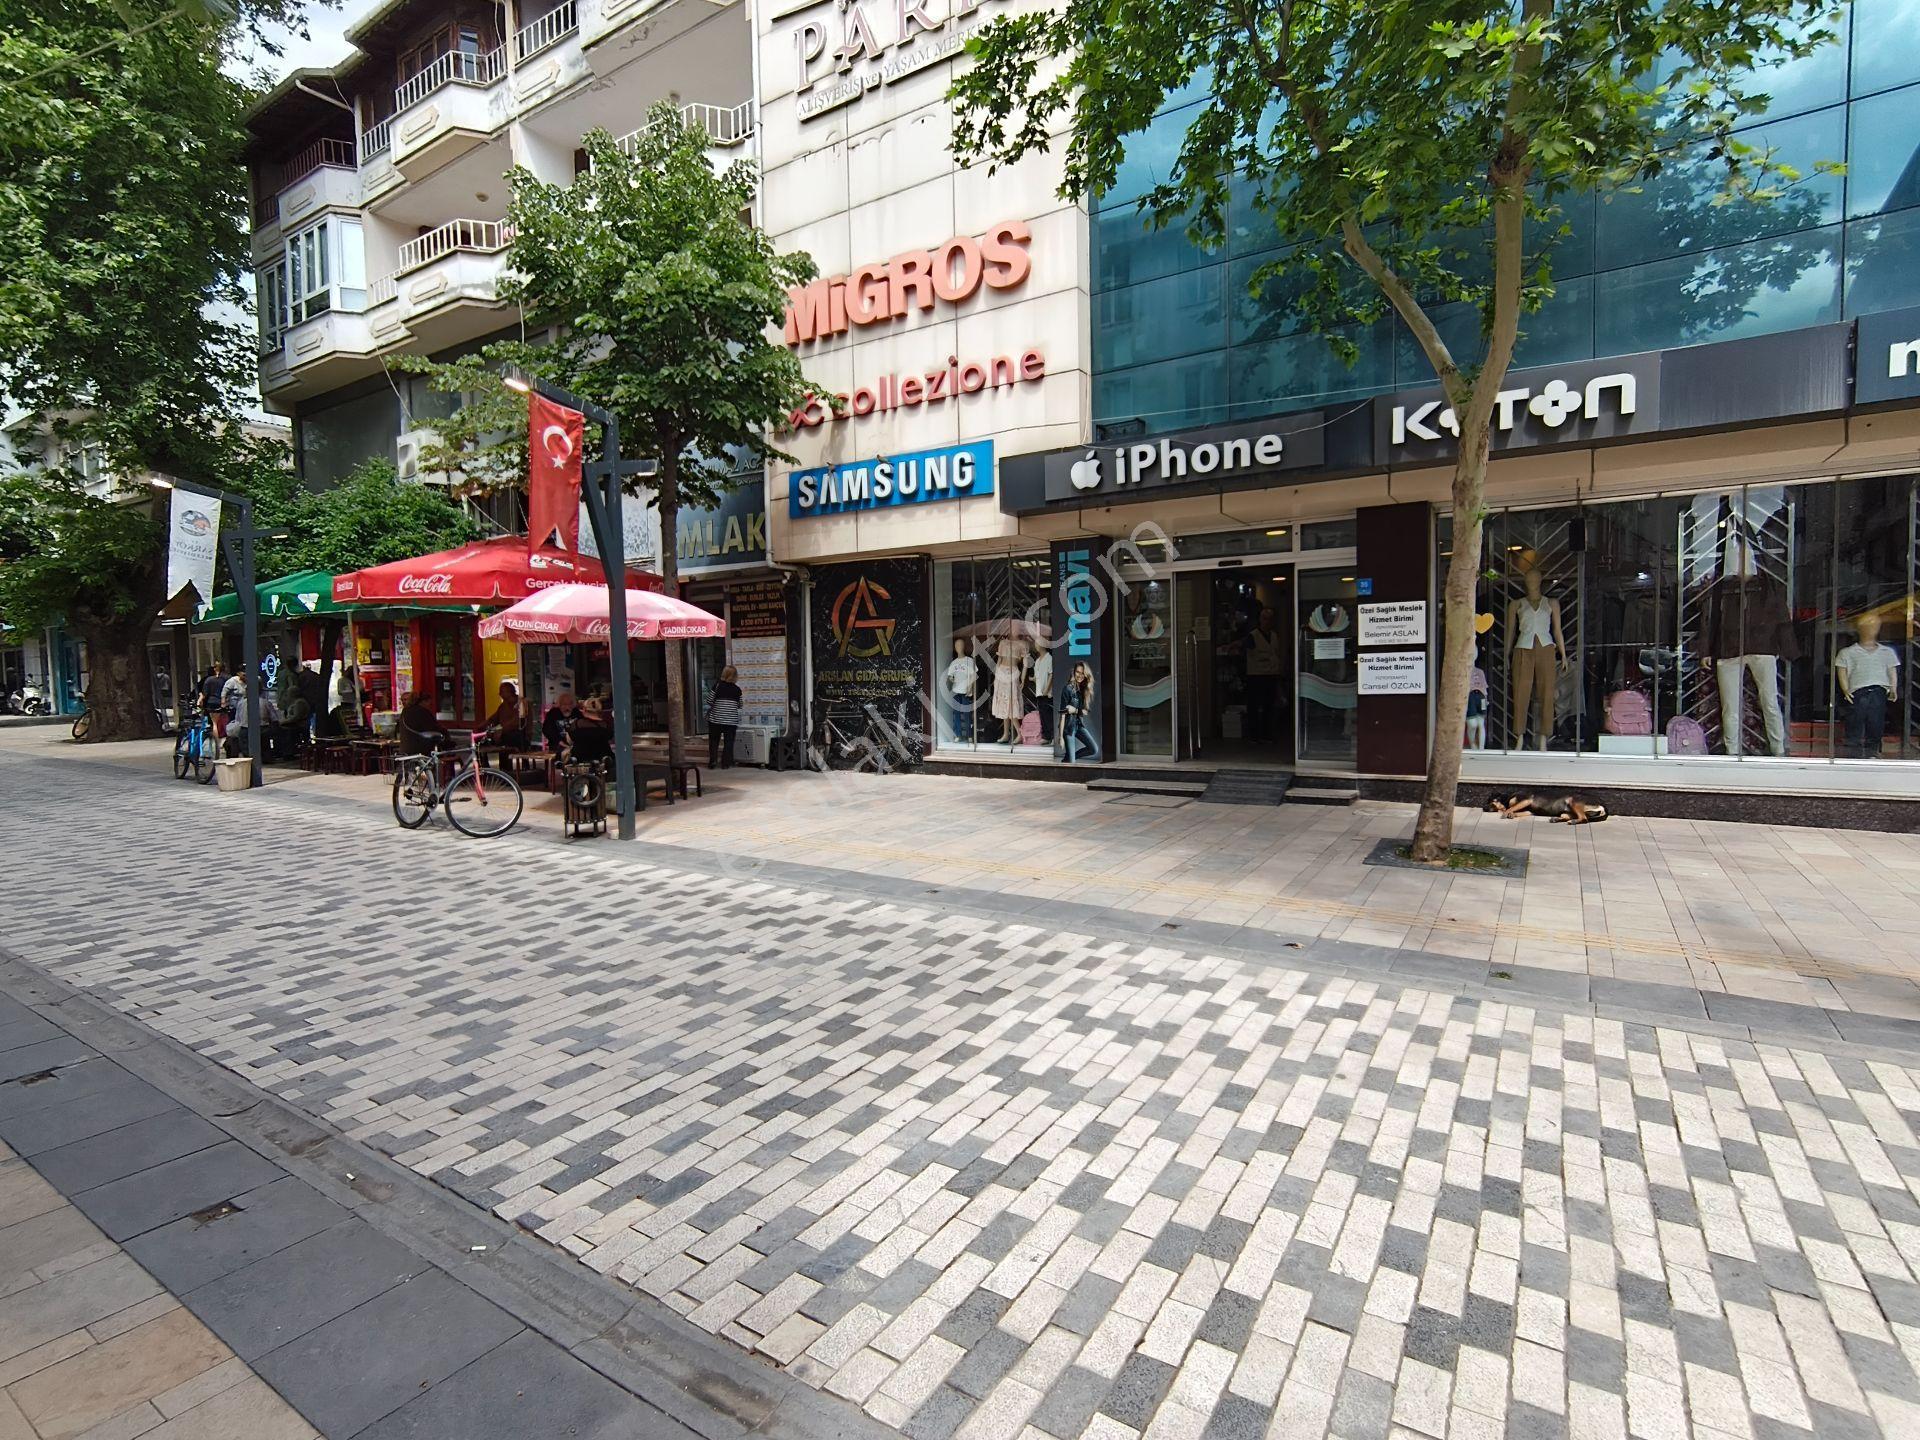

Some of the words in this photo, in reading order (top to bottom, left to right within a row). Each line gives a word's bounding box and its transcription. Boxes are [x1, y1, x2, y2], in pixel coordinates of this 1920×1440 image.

[793, 0, 979, 93] PAR
[798, 450, 976, 508] SAMSUNG
[1115, 434, 1283, 485] iPhone
[677, 511, 766, 560] MLAK
[1059, 549, 1092, 656] mavi
[1376, 606, 1397, 614] Sağlık
